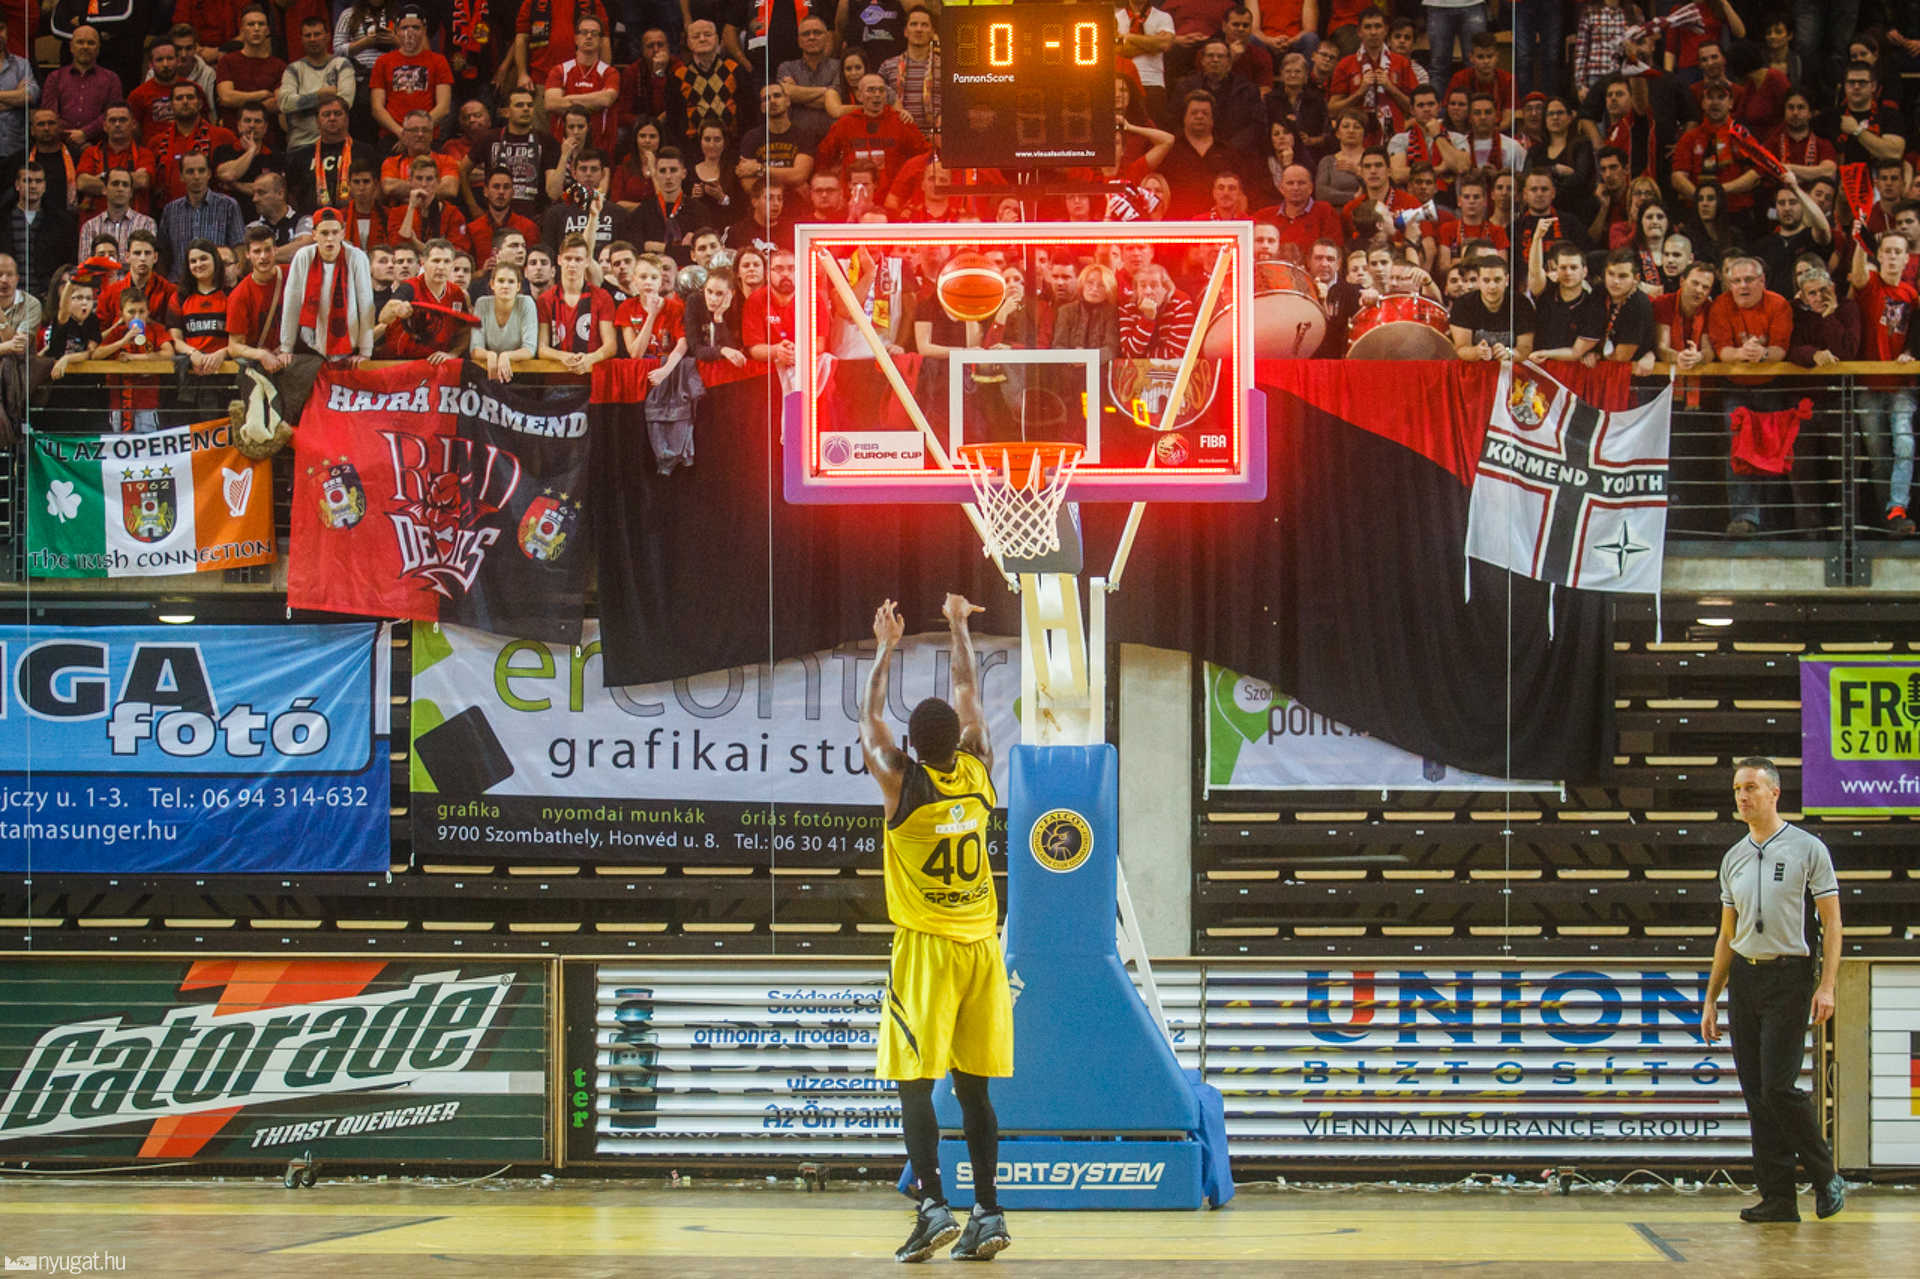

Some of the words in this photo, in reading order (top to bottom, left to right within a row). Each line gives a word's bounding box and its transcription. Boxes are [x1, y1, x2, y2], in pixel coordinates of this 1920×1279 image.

[988, 22, 1014, 68] 0
[1074, 22, 1098, 66] 0
[953, 73, 1015, 84] PannonScore
[328, 378, 430, 413] HAJRÁ
[437, 381, 588, 438] KÖRMEND
[74, 440, 107, 461] AZ
[854, 451, 897, 459] EUROPE
[901, 451, 922, 459] CUP
[1200, 435, 1227, 448] FIBA
[1486, 440, 1589, 487] KÖRMEND
[1601, 474, 1663, 494] YOUTH
[126, 482, 170, 493] 1962
[107, 697, 330, 757] fotó
[548, 728, 769, 779] grafikai
[1841, 731, 1920, 754] SZOM
[0, 786, 48, 812] jczy
[56, 791, 77, 808] u.
[86, 787, 129, 808] 1-3.
[148, 786, 195, 809] Tel.:
[202, 788, 231, 809] 06
[238, 788, 265, 808] 94
[273, 786, 368, 808] 314-632
[437, 801, 501, 819] grafika
[542, 805, 623, 822] nyomdai
[631, 807, 706, 824] munkák
[437, 825, 480, 842] 9700
[485, 825, 603, 849] Szombathely,
[609, 829, 677, 848] Honvéd
[683, 834, 699, 849] u.
[704, 833, 720, 849] 8.
[734, 833, 769, 851] Tel.:
[774, 834, 794, 851] 06
[801, 835, 823, 852] 30
[827, 836, 847, 852] 41
[854, 836, 875, 853] 48
[921, 832, 982, 886] 40
[1306, 970, 1722, 1044] UNION
[2, 976, 506, 1132] Gatorade
[1303, 1056, 1720, 1085] BIZTOSÍTÓ
[251, 1118, 337, 1149] THIRST
[335, 1101, 460, 1136] QUENCHER
[1303, 1118, 1417, 1137] VIENNA
[1428, 1118, 1605, 1137] INSURANCE
[1618, 1118, 1720, 1137] GROUP
[956, 1162, 1165, 1189] SORTSYSTEM
